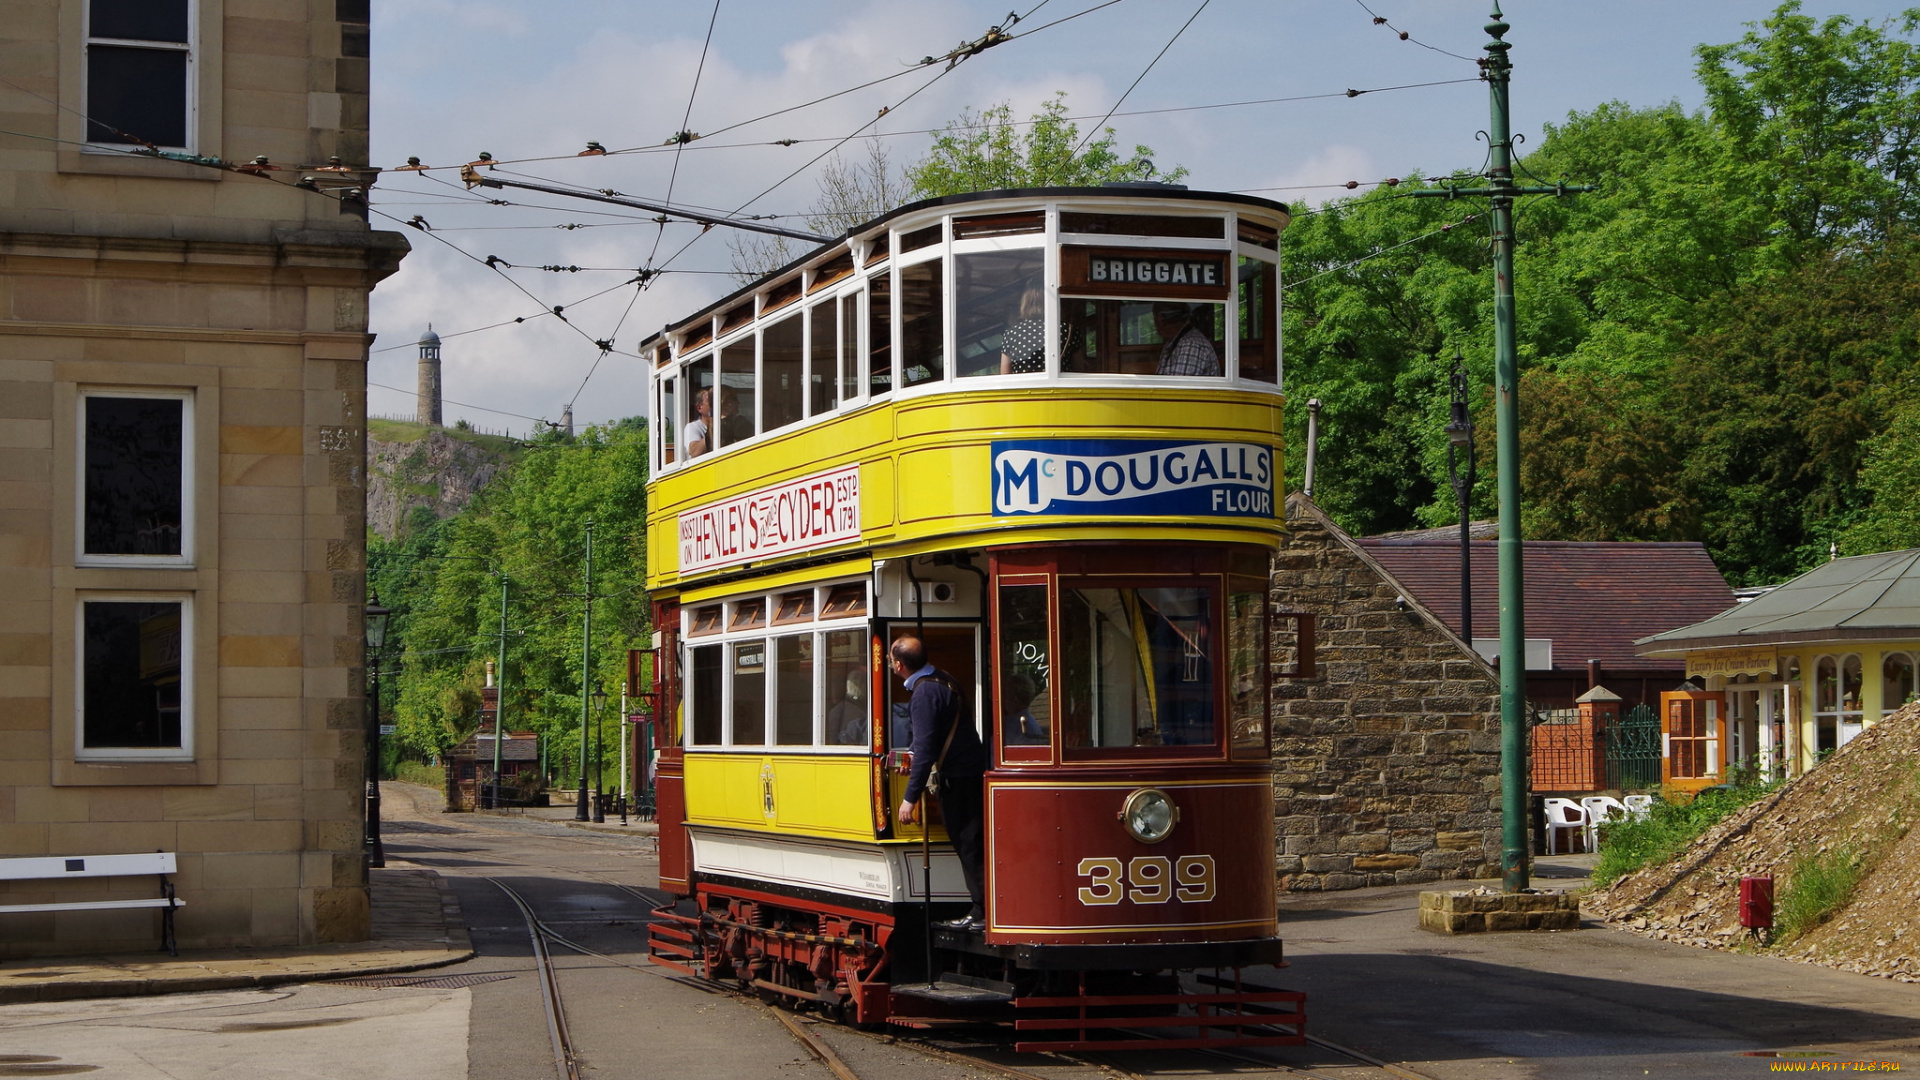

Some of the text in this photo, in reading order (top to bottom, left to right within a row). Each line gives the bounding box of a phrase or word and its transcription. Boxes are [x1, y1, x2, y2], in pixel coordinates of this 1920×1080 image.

[1091, 259, 1217, 285] BRIGGATE
[777, 481, 836, 544] CYDER
[1211, 488, 1271, 515] FLOUR
[680, 518, 695, 543] INSIST
[695, 498, 759, 562] HENLEY'S
[839, 505, 857, 531] 1791
[684, 545, 693, 565] ON
[1690, 654, 1772, 675] Luxury Ice Cream Parlour
[1077, 854, 1217, 907] 399
